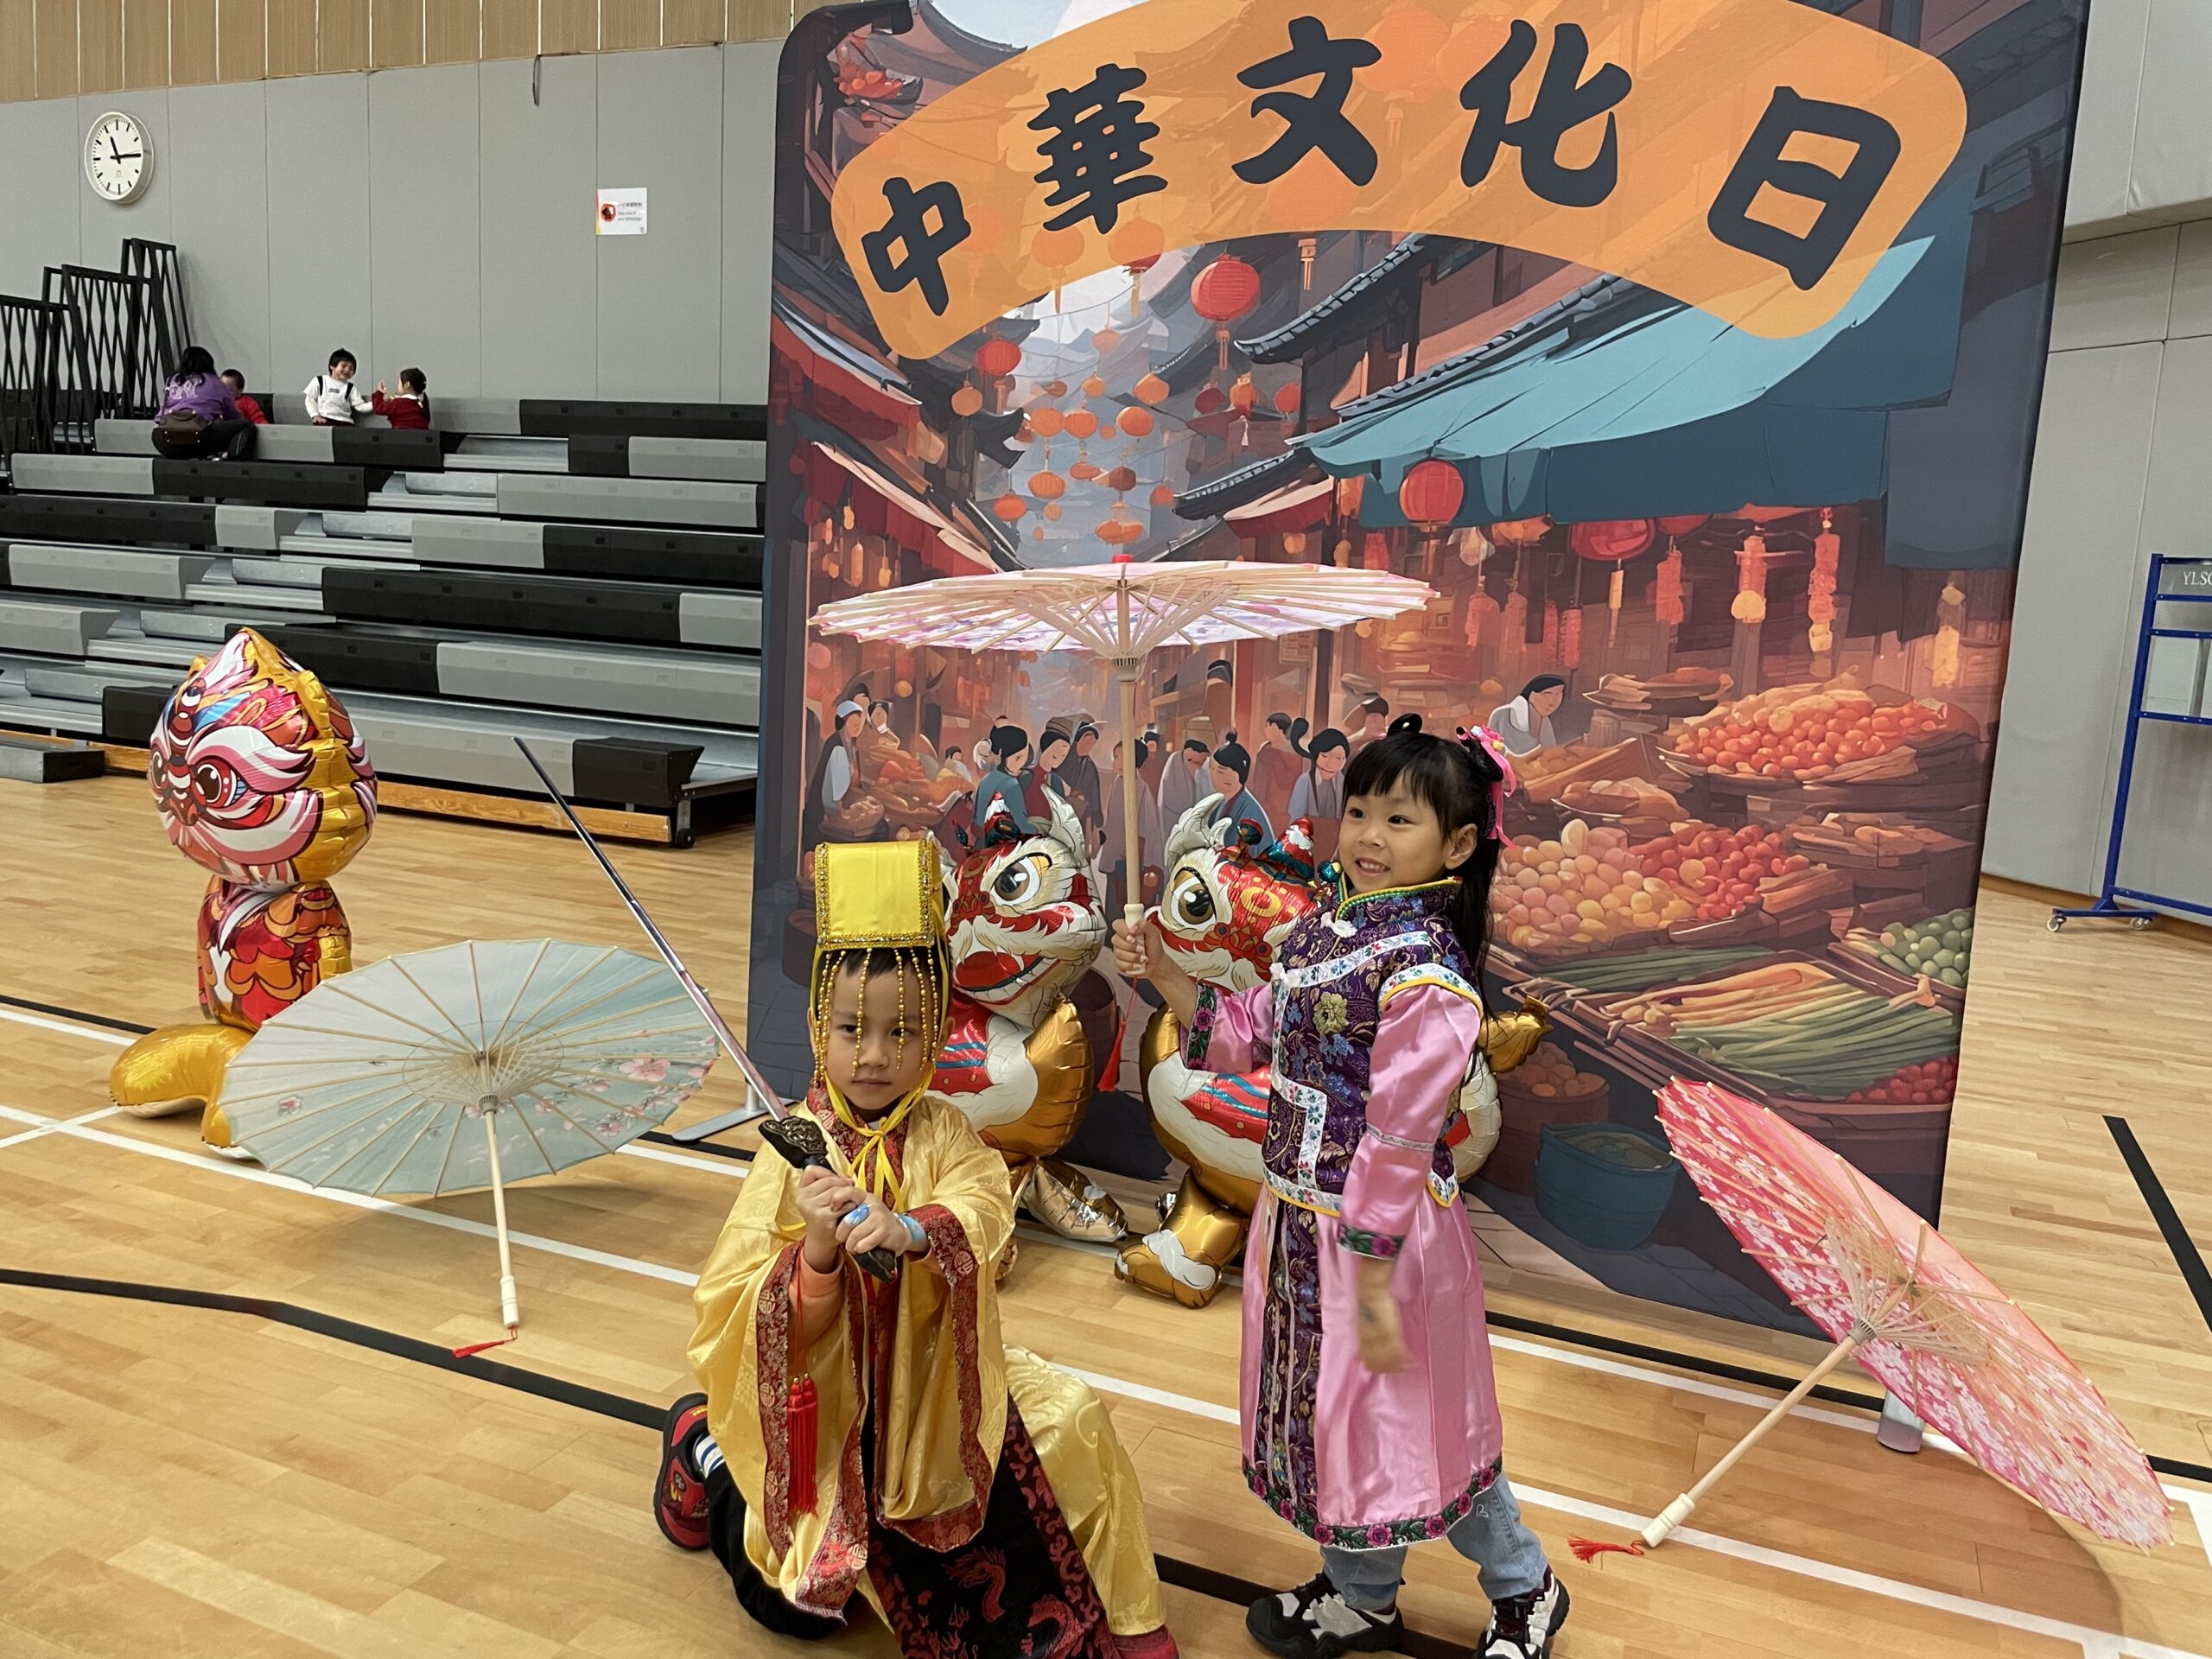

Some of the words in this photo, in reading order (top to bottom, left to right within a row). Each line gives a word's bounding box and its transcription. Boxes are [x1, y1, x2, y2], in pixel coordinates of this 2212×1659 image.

[861, 16, 1900, 315] 中華文化日
